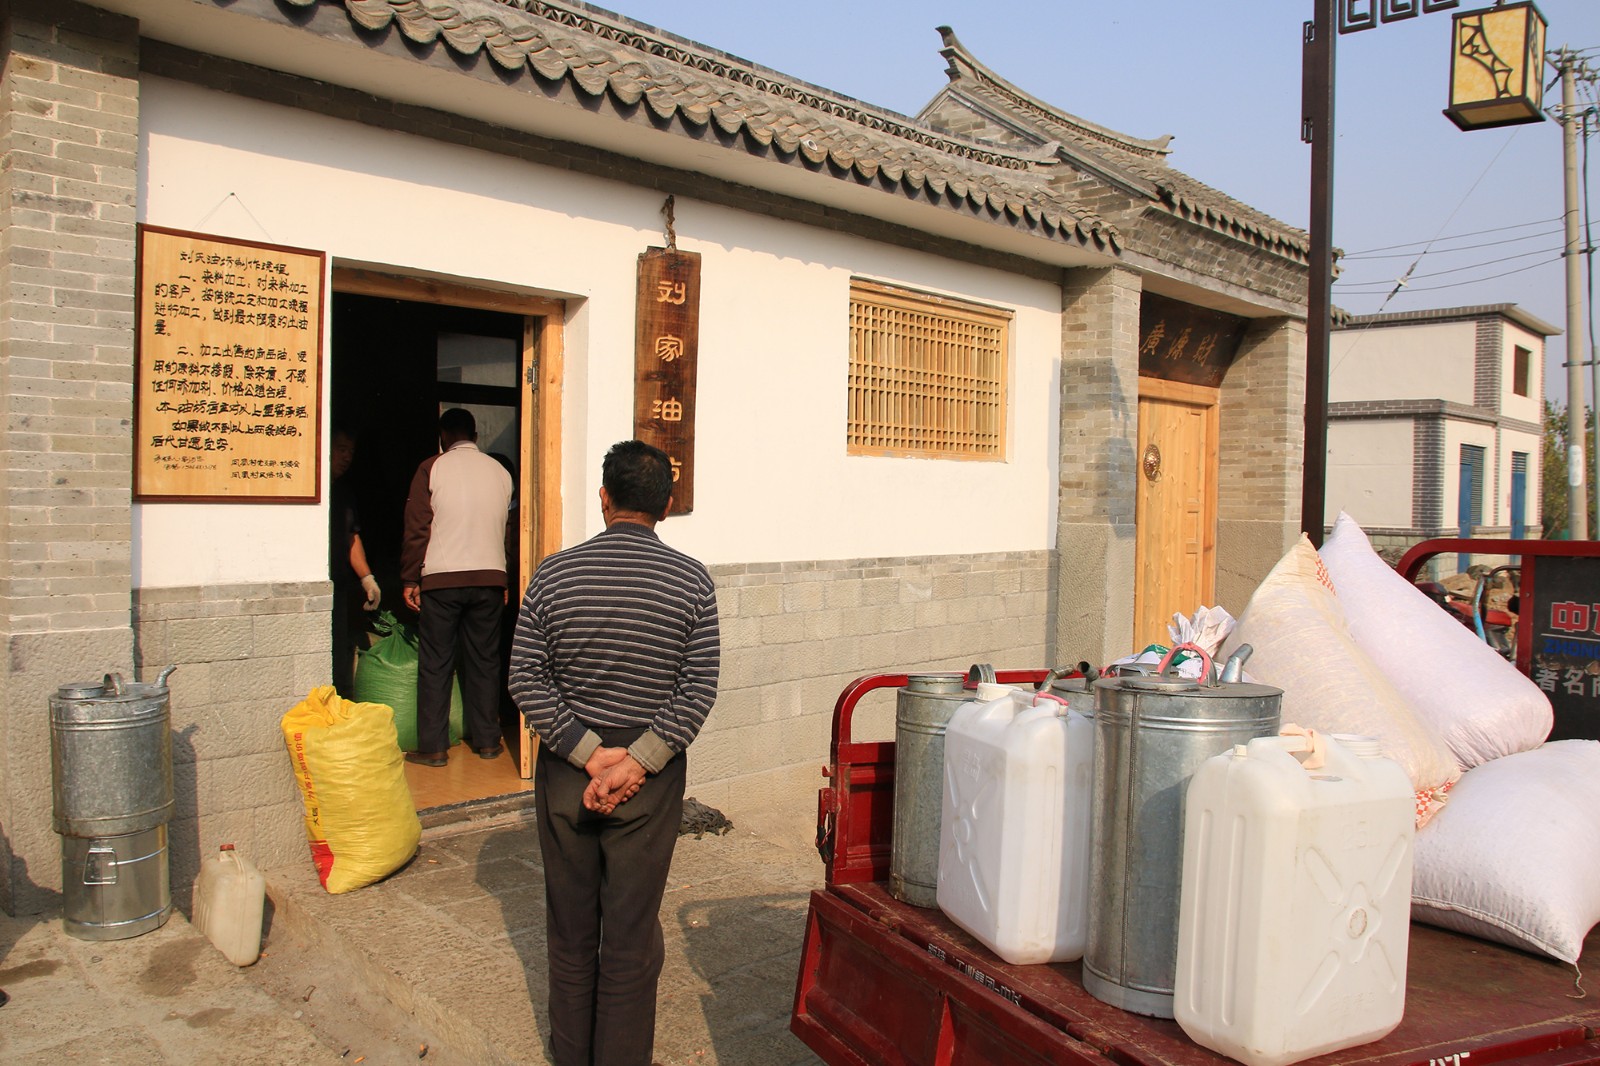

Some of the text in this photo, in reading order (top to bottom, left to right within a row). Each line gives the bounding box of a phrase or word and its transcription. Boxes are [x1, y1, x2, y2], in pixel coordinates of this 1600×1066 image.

[652, 280, 686, 483] 刘家油
[1551, 601, 1600, 634] 中
